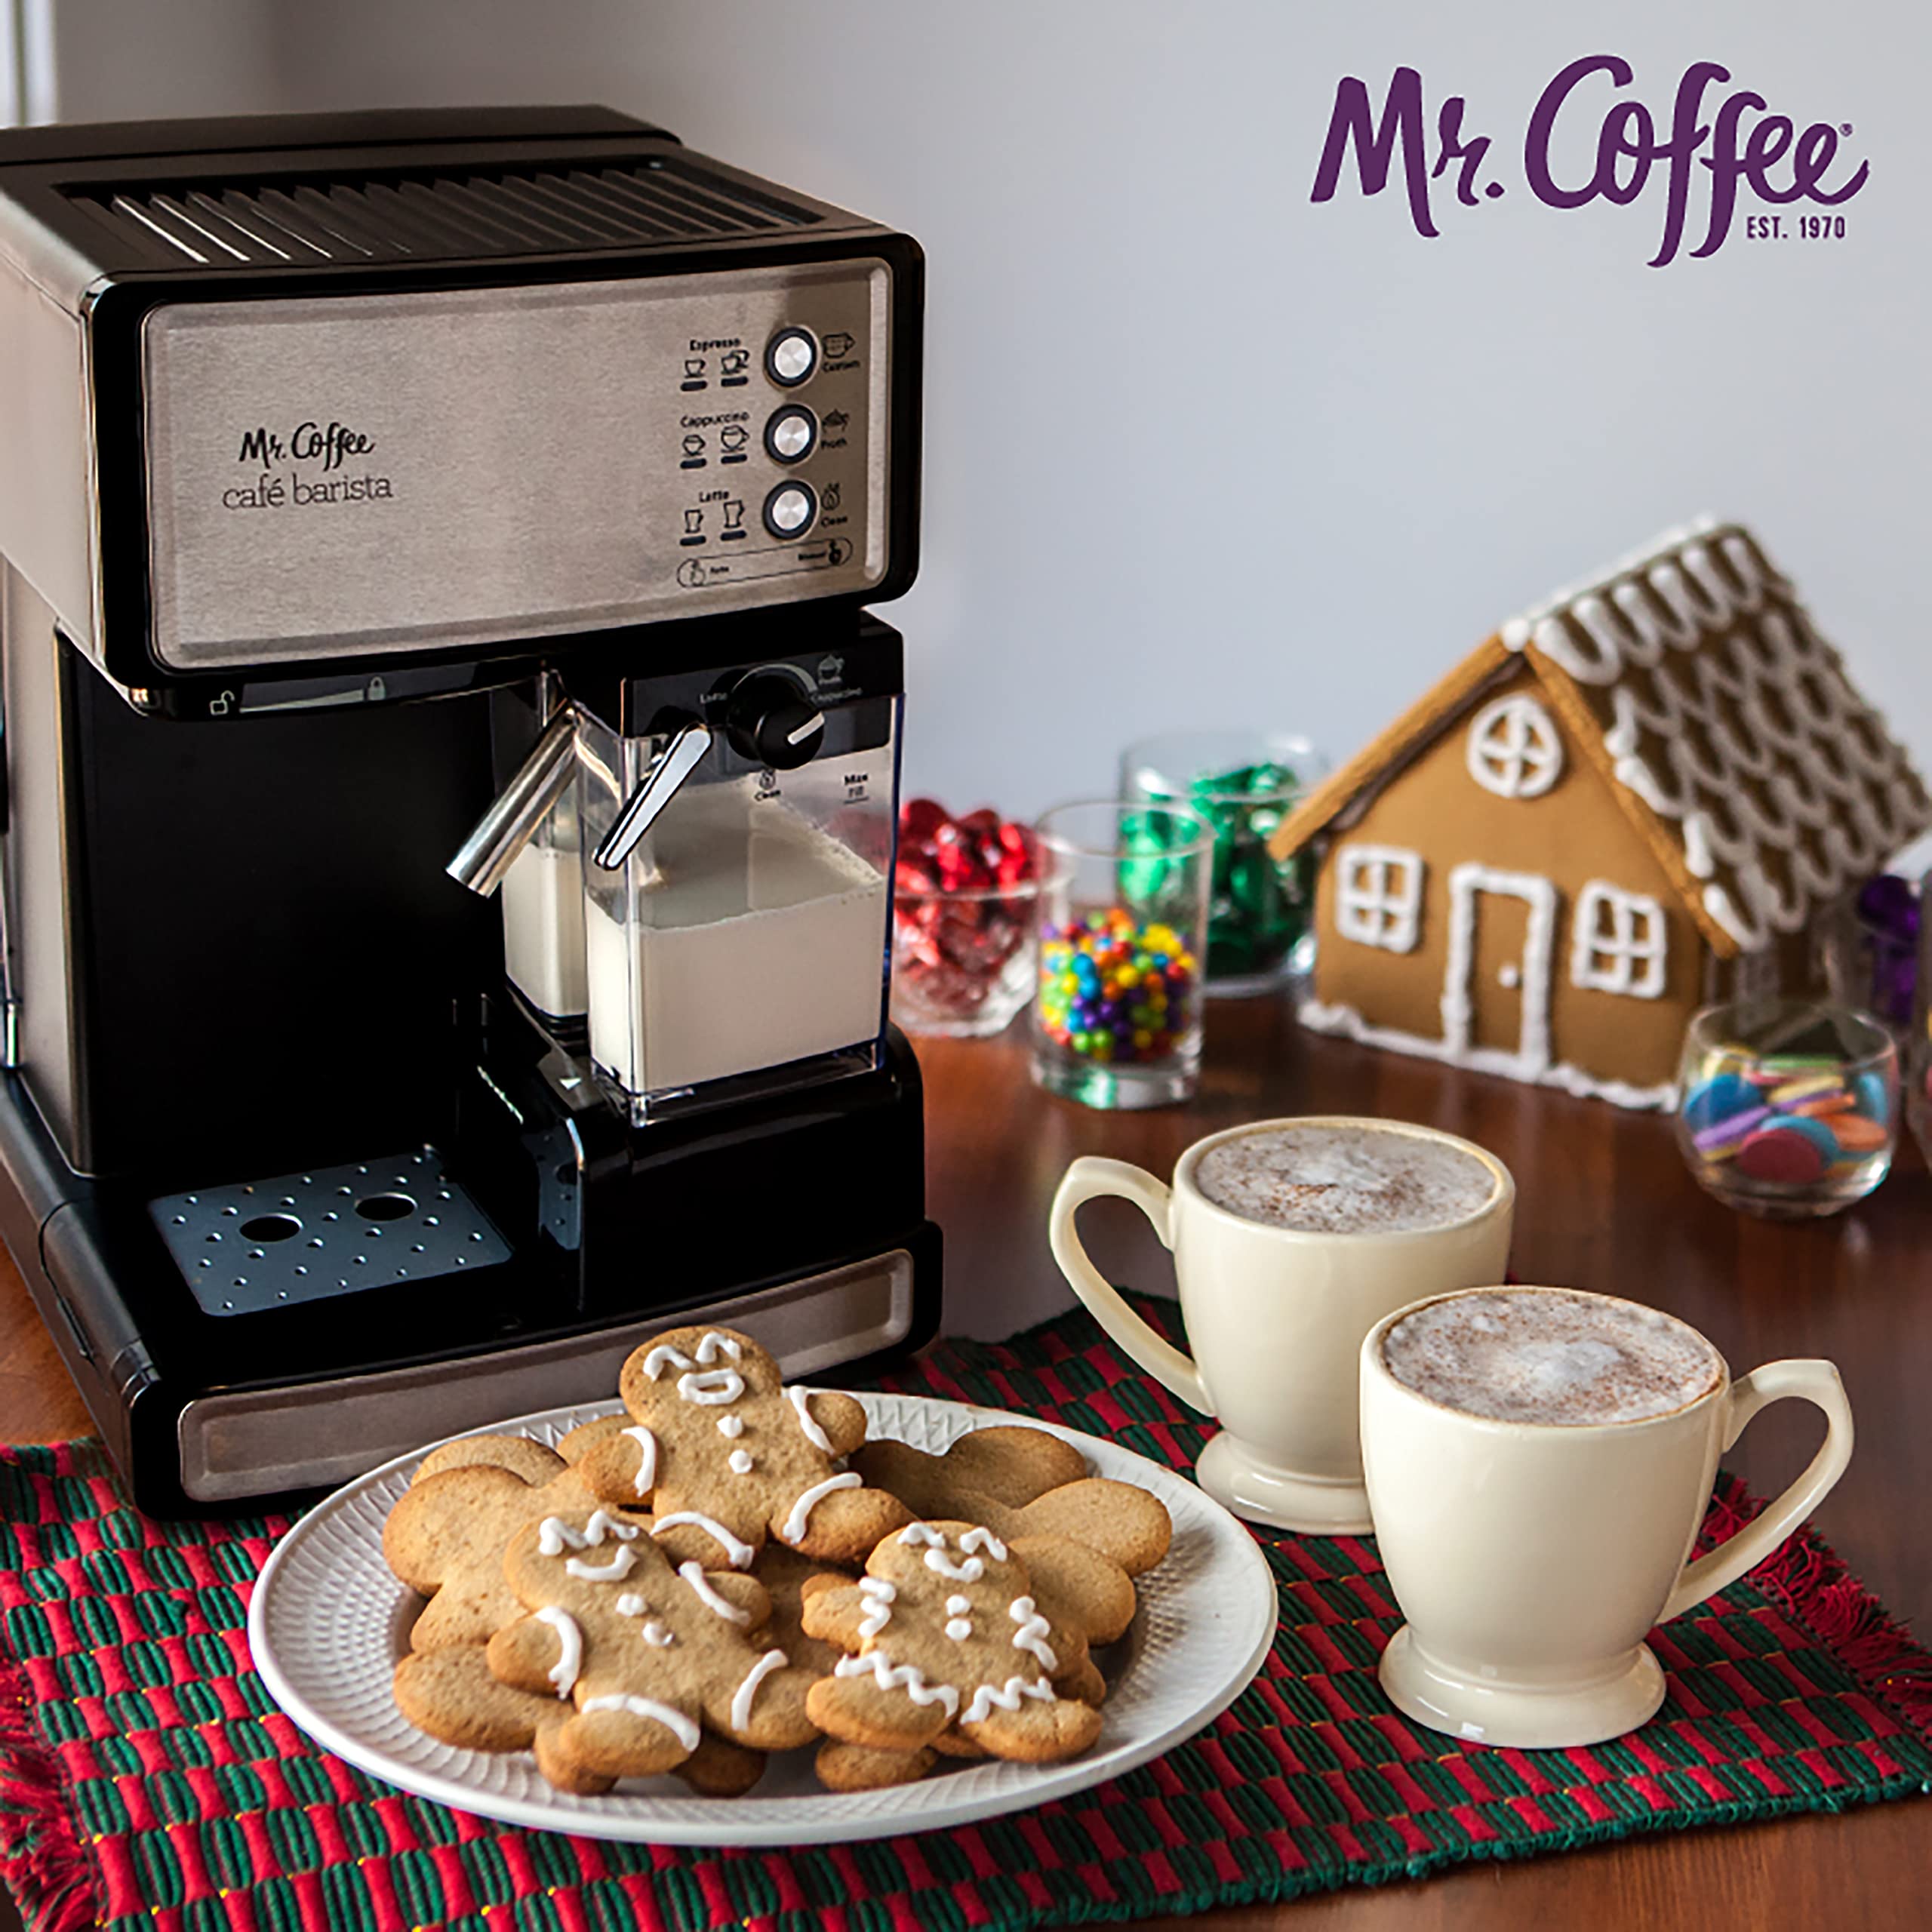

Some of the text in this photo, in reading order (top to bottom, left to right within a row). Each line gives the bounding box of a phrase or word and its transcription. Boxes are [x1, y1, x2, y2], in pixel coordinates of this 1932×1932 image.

[239, 422, 375, 472] Mr. Coffee
[223, 472, 393, 509] café barista
